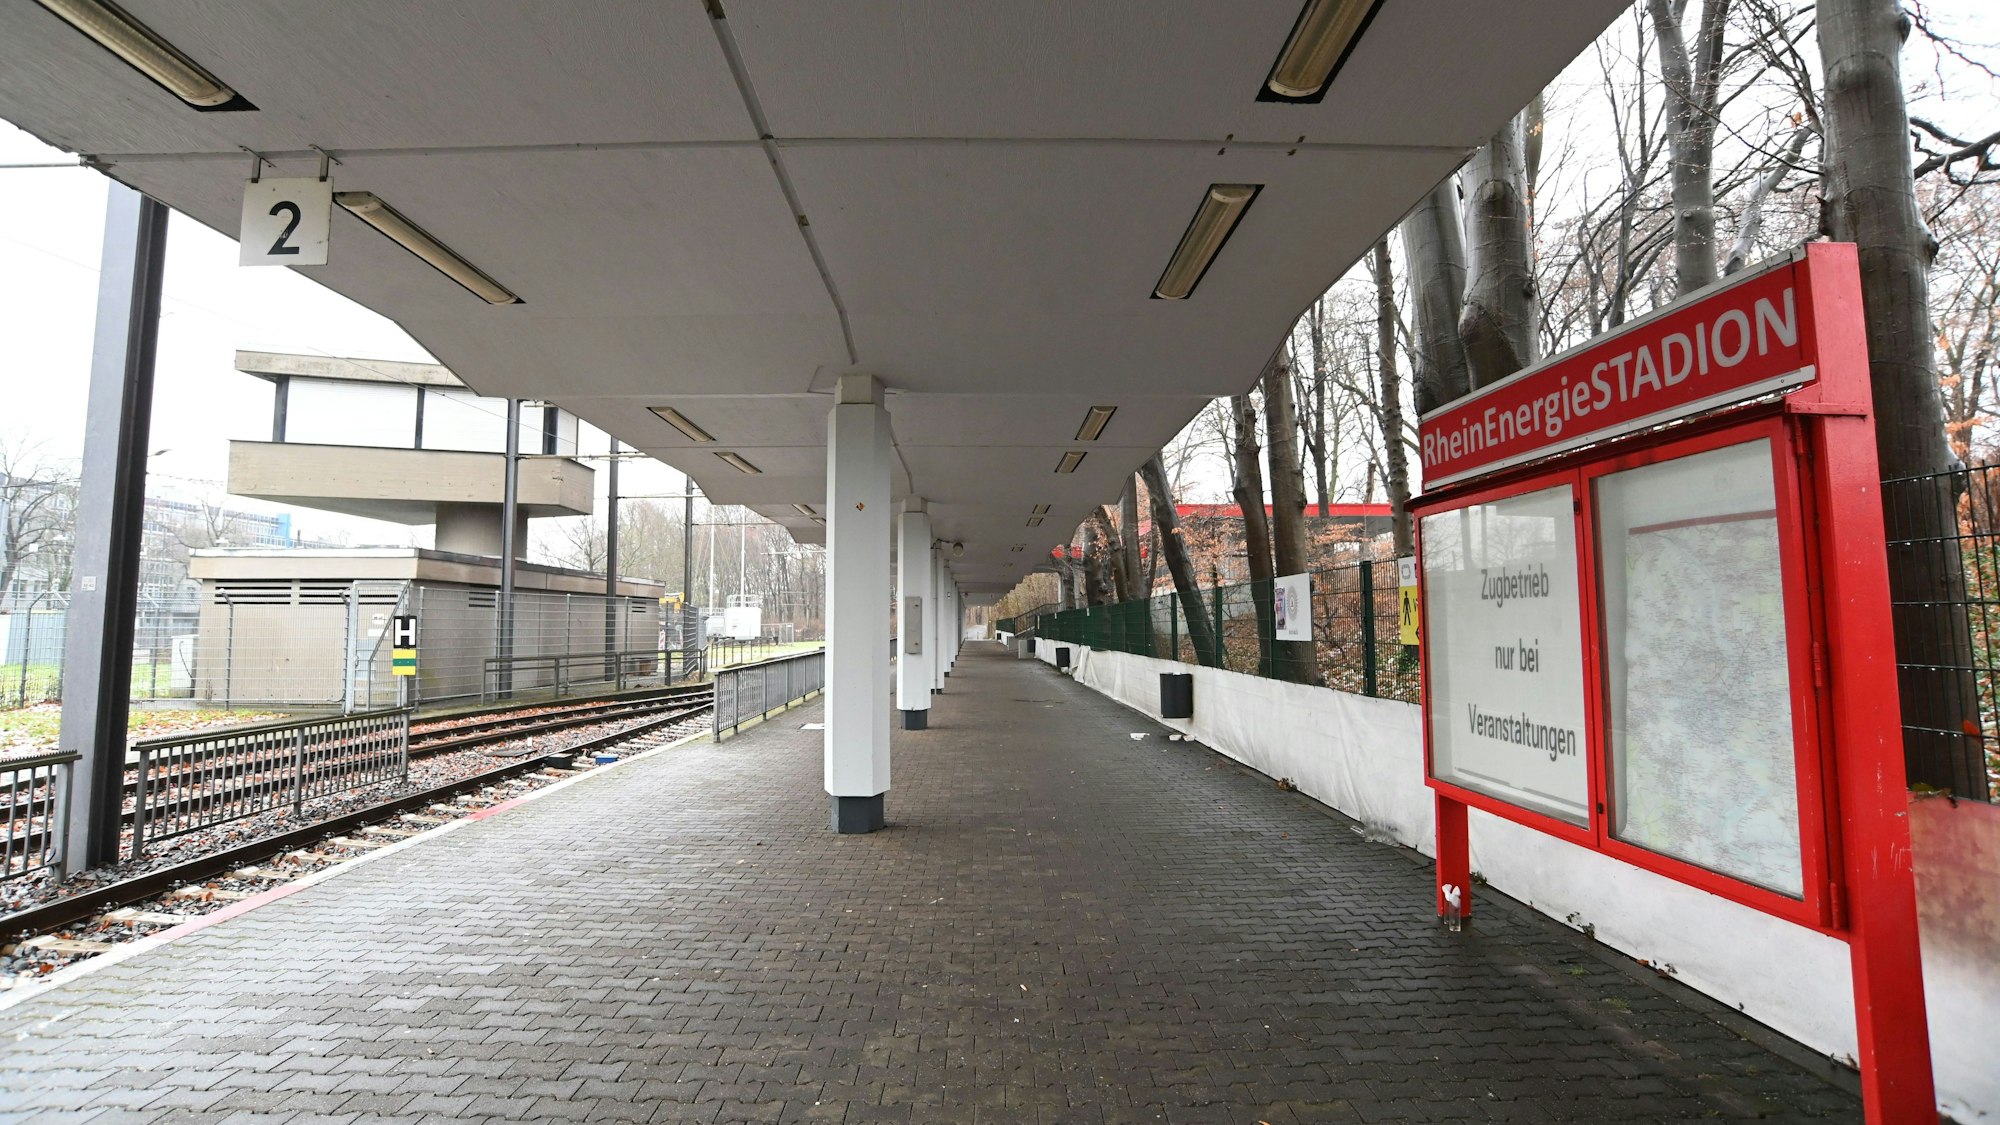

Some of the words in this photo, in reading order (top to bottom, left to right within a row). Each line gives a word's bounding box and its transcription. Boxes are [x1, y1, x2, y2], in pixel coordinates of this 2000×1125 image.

[267, 200, 301, 255] 2
[1423, 287, 1798, 469] RheinEnergieSTADION
[1481, 563, 1549, 608] Zugbetrieb
[394, 618, 416, 646] H
[1495, 646, 1515, 670] nur
[1519, 638, 1539, 672] bei
[1467, 702, 1576, 762] Veranstaltungen
